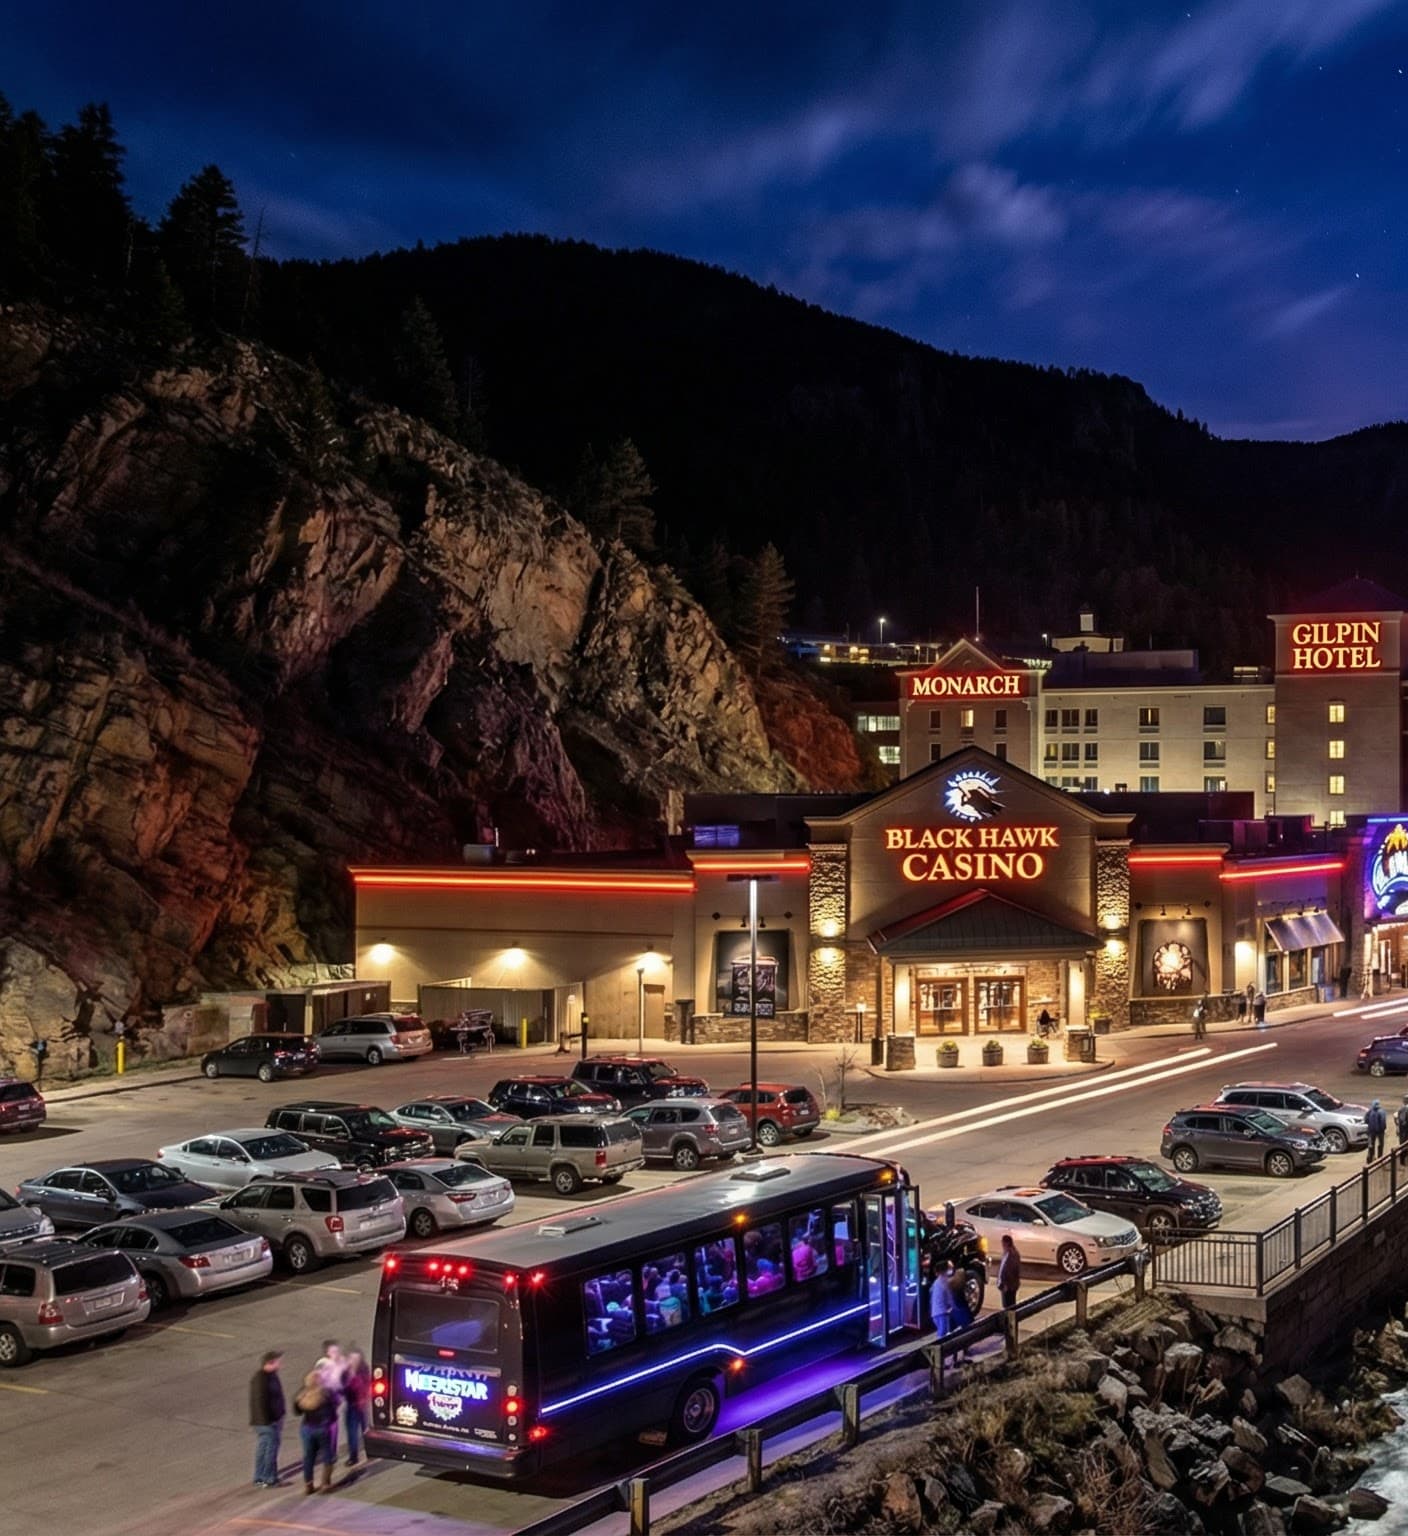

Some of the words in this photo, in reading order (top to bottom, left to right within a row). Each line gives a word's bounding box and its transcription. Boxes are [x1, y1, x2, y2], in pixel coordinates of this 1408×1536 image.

[1293, 622, 1380, 645] GILPIN
[1293, 647, 1380, 669] HOTEL
[912, 675, 1020, 695] MONARCH
[886, 829, 972, 849] BLACK
[979, 827, 1058, 848] HAWK
[902, 853, 1043, 881] CASINO
